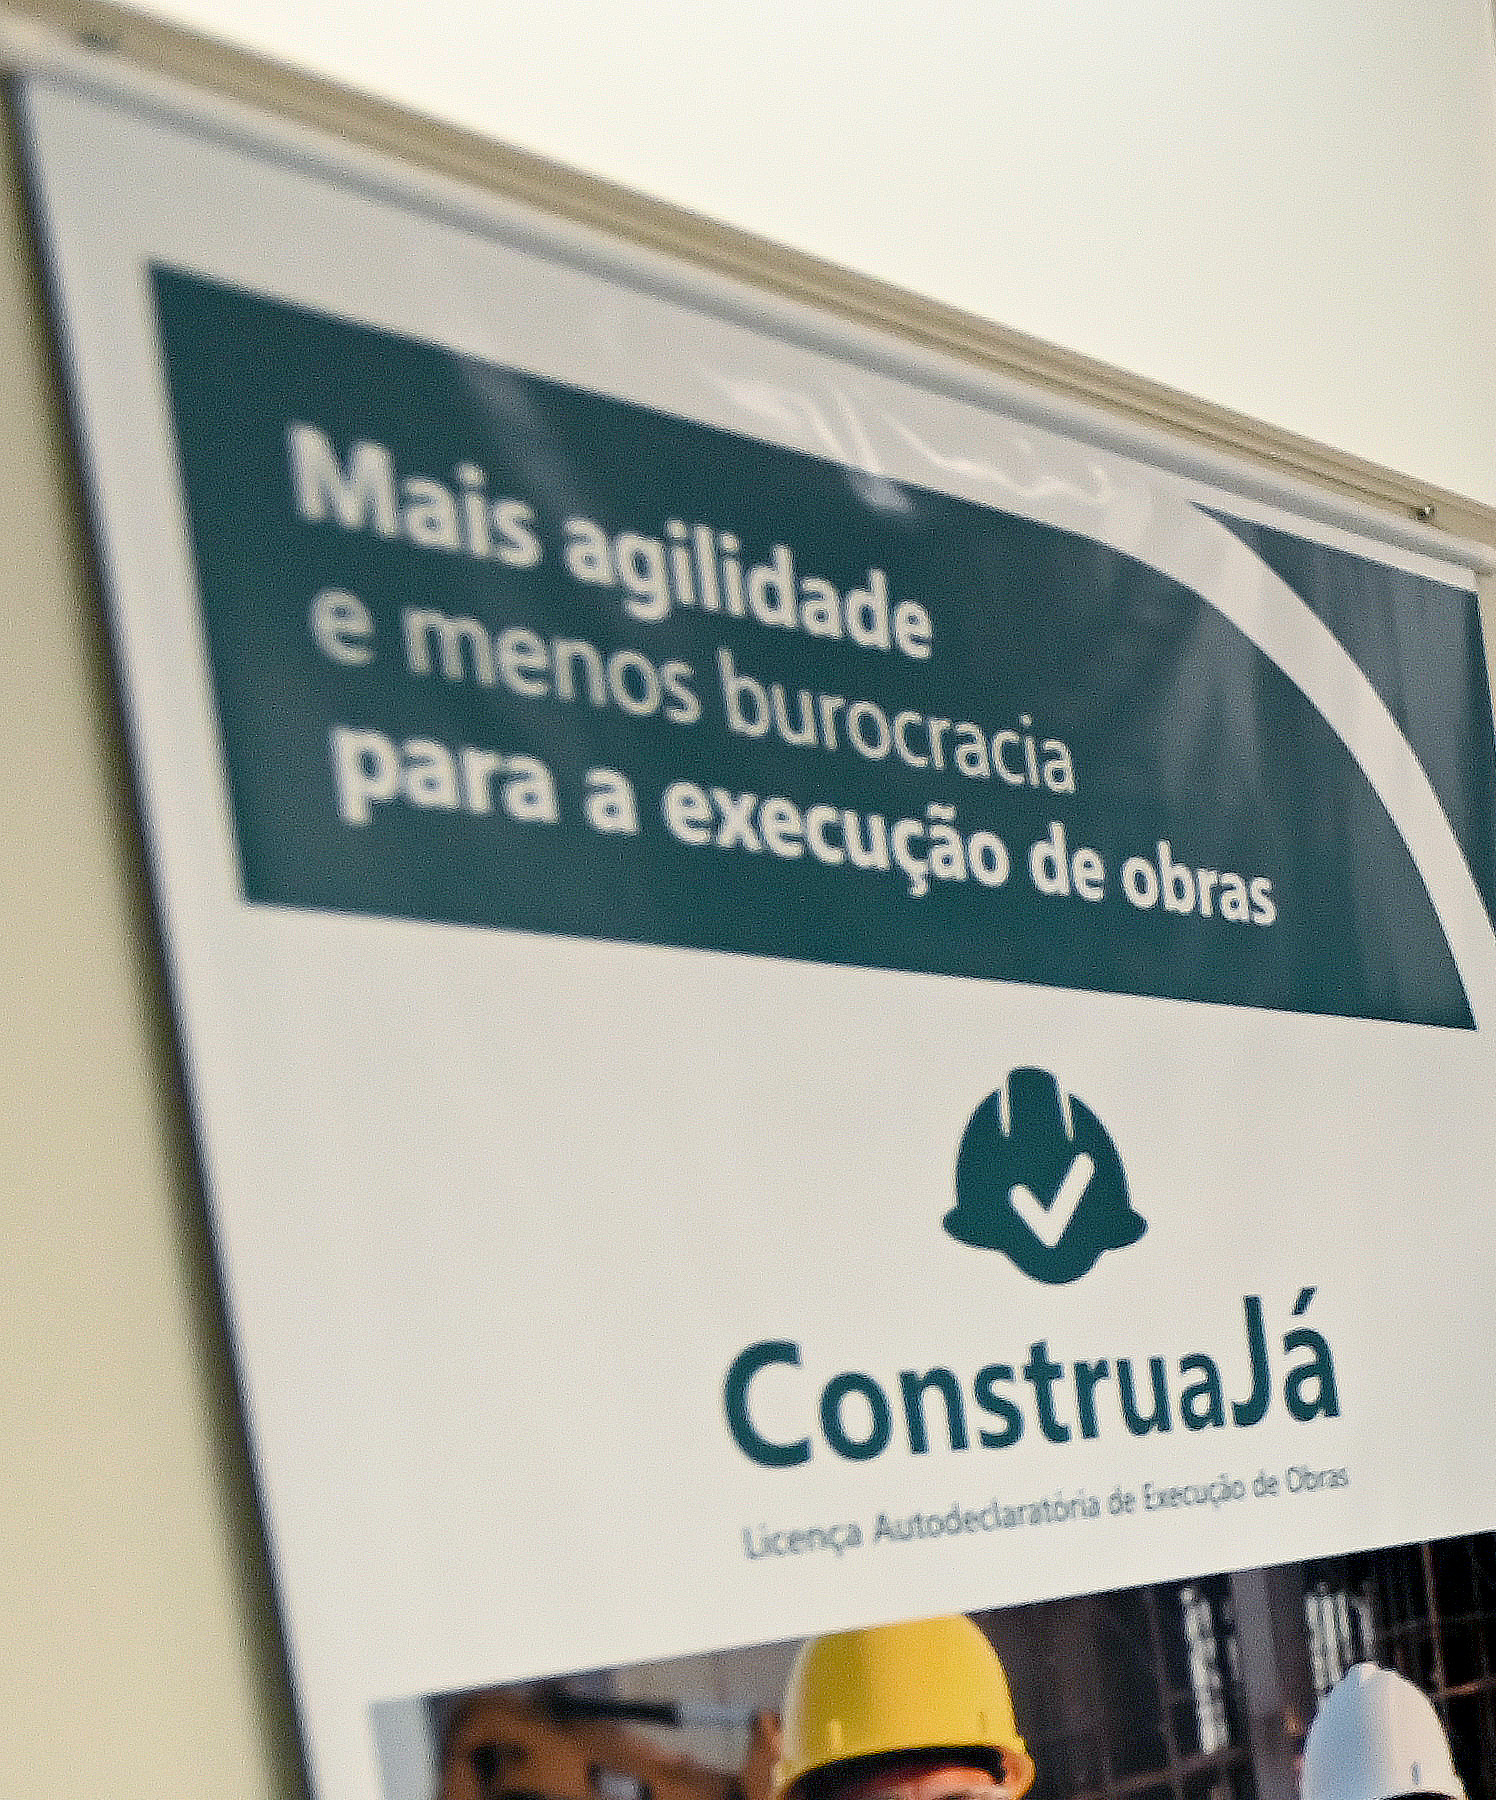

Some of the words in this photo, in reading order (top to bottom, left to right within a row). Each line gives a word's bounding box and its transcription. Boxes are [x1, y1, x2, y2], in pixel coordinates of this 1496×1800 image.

[287, 424, 542, 567] Mais
[563, 511, 934, 660] agilidade
[312, 587, 374, 664] e
[406, 606, 700, 725] menos
[720, 649, 1076, 795] burocracia
[331, 725, 558, 826] para
[585, 762, 638, 834] a
[665, 780, 1008, 898] execução
[1030, 820, 1105, 903] de
[1122, 840, 1278, 928] obras
[723, 1286, 1341, 1469] ConstruaJá
[742, 1518, 864, 1561] Licença
[873, 1487, 1101, 1544] Autodeclaratória
[1107, 1485, 1137, 1516] de
[1144, 1470, 1245, 1515] Execução
[1252, 1469, 1279, 1498] de
[1286, 1463, 1350, 1494] Obras
